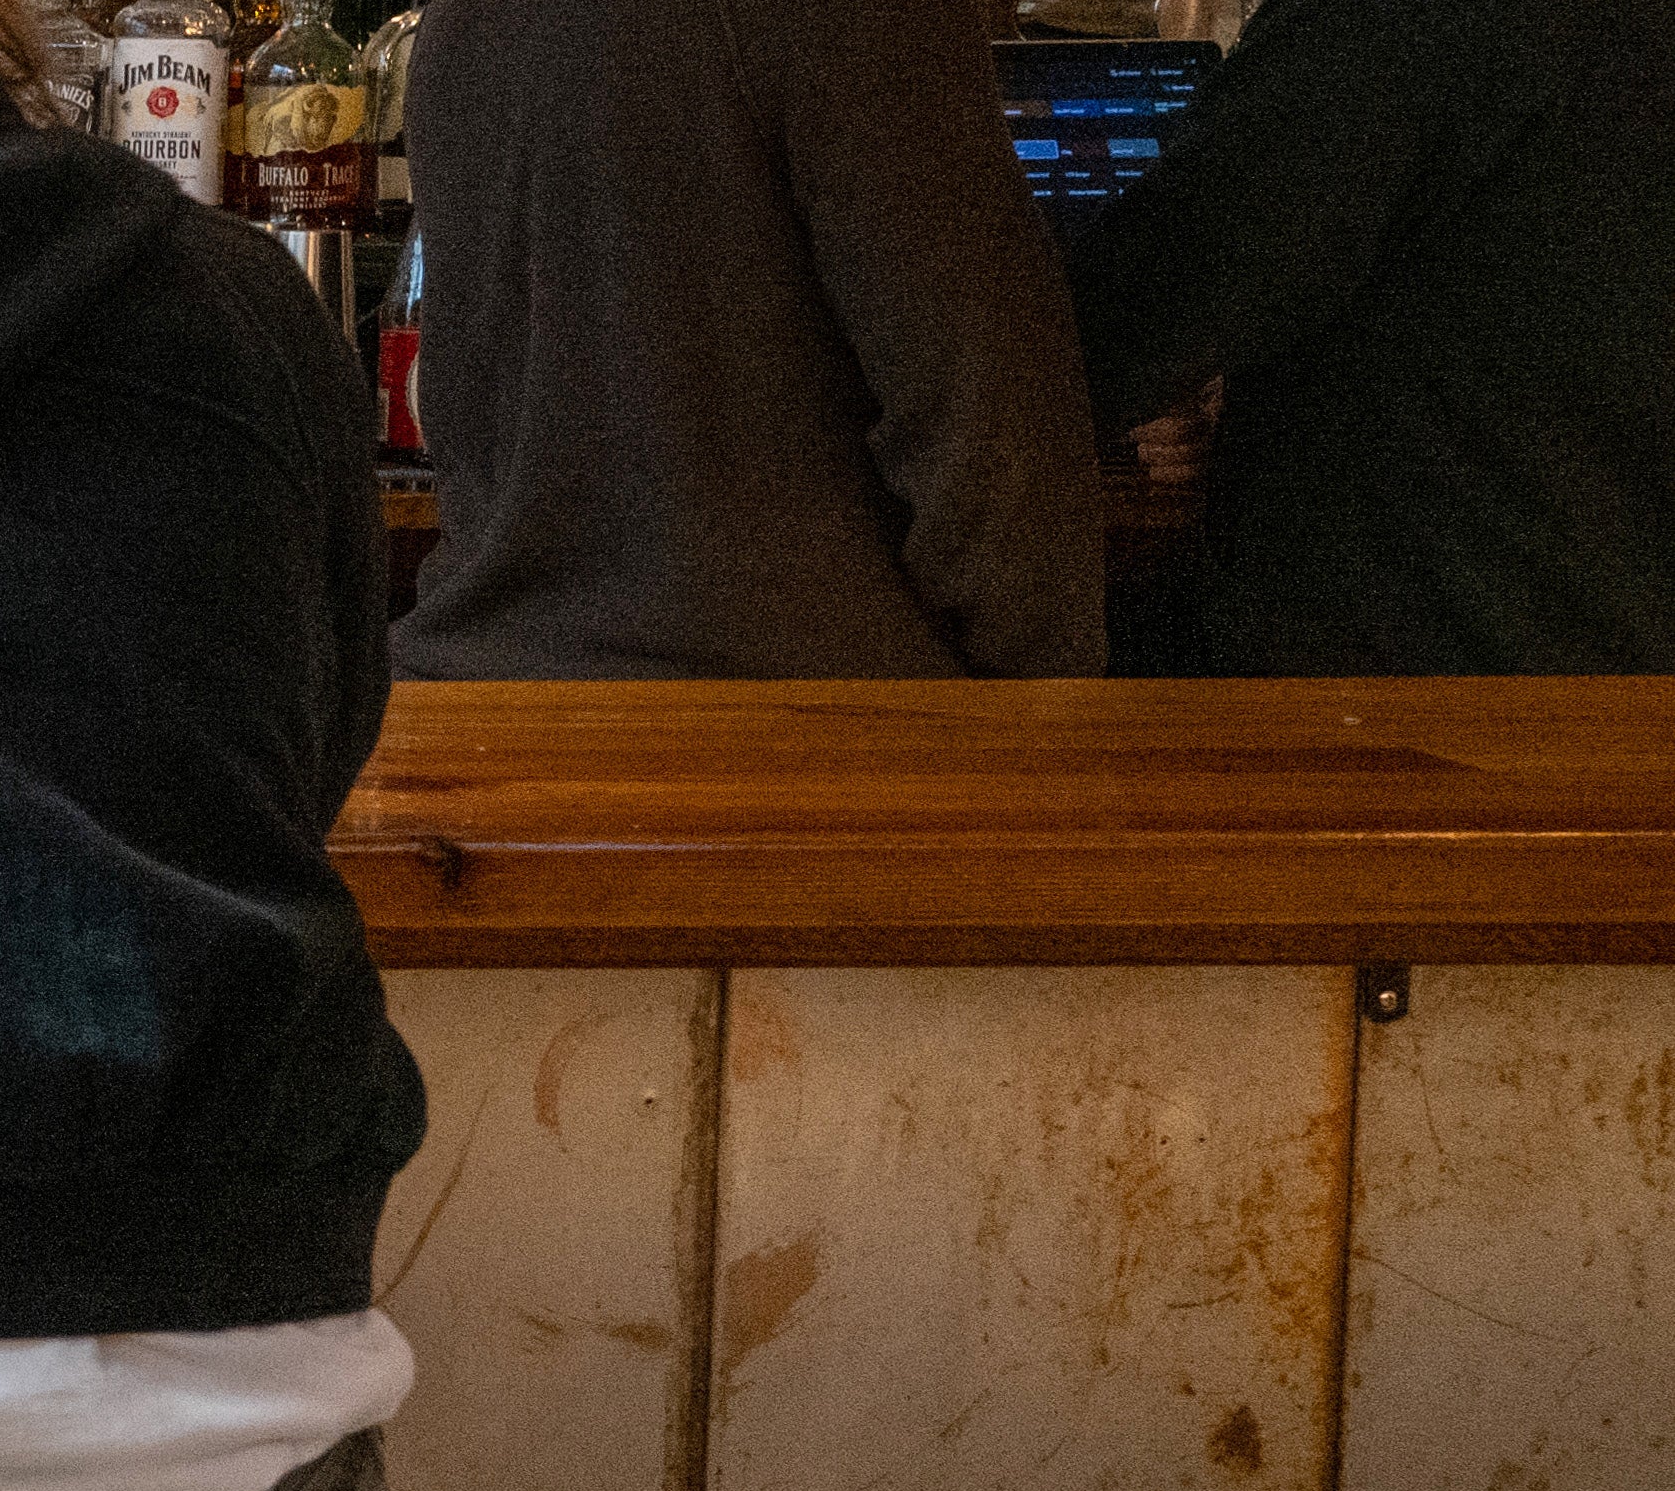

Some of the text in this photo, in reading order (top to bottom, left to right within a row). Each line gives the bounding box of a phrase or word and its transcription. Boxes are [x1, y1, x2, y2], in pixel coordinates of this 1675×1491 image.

[119, 55, 211, 96] JIM BEAM
[47, 80, 94, 110] DNIEL'S
[123, 139, 201, 159] BOURBON
[258, 162, 356, 187] BUFFALO TRACE
